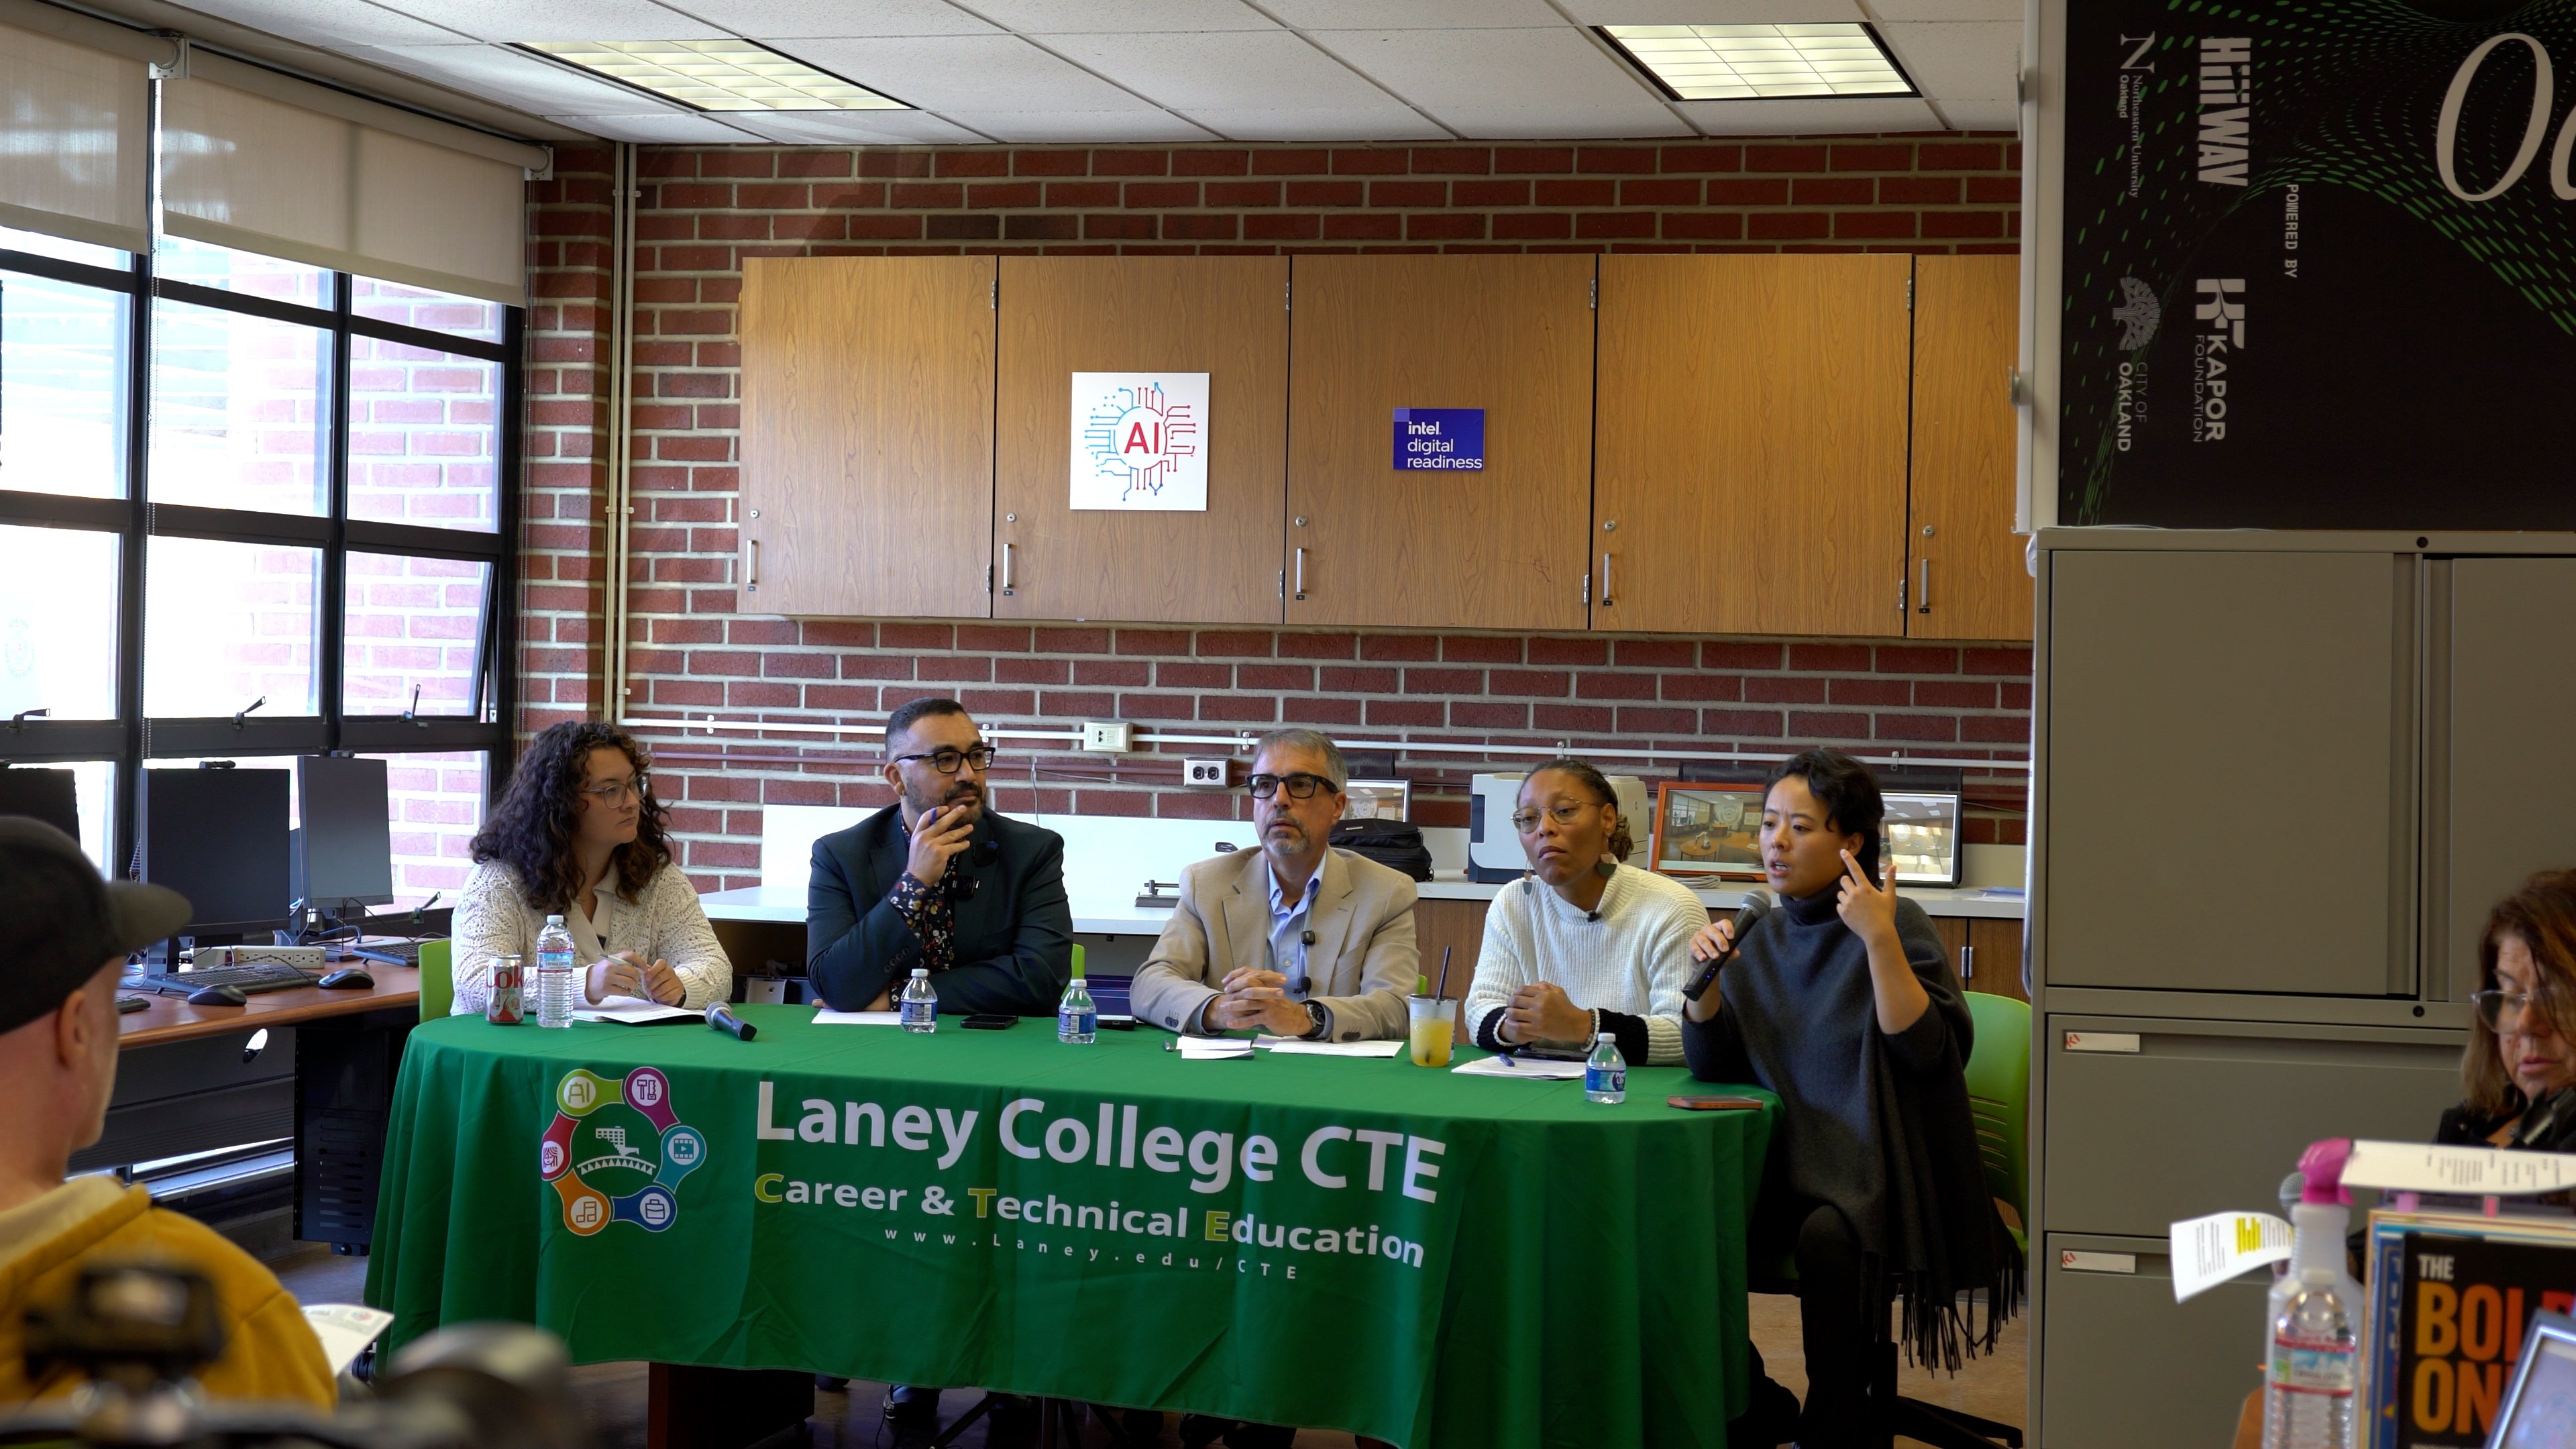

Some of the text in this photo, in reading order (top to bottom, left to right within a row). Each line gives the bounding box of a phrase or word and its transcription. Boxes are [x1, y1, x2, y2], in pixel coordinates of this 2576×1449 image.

[2119, 74, 2129, 118] Oakland
[2128, 75, 2143, 198] Northeastern University
[2284, 184, 2300, 278] POWERED BY
[2117, 362, 2133, 451] OAKLAND
[2135, 362, 2148, 423] CITY OF
[2192, 335, 2205, 443] FOUNDATION
[2205, 335, 2227, 441] KAPOR
[1124, 422, 1159, 454] AI
[1407, 438, 1454, 455] digital
[1407, 454, 1483, 469] readiness
[757, 1081, 1446, 1203] Laney College CTE
[754, 1173, 1424, 1269] Career & Technical Education
[2417, 1253, 2455, 1280] THE
